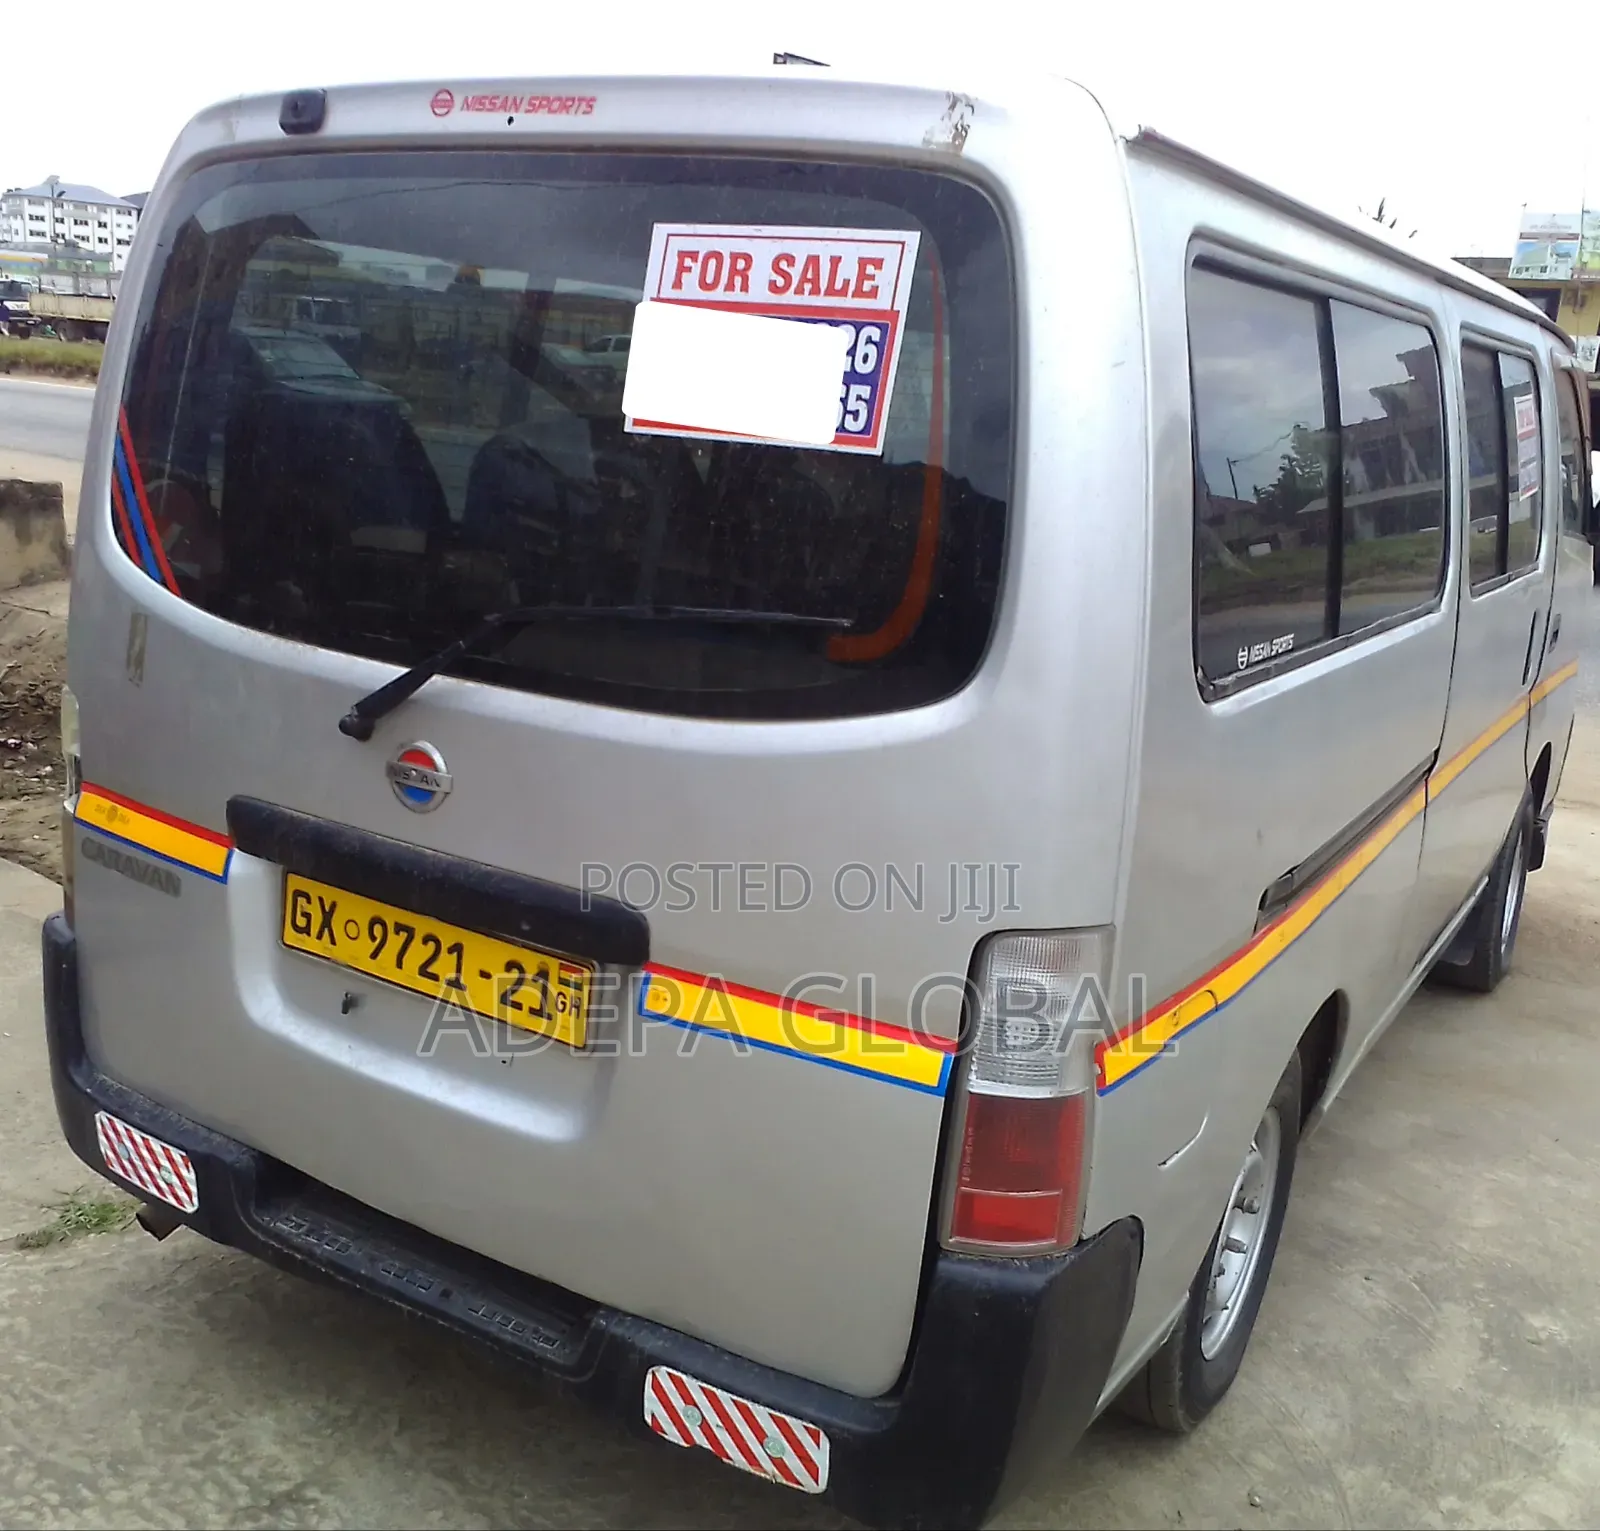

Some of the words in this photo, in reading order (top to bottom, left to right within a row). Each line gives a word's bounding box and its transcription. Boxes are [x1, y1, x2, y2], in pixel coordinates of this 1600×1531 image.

[460, 95, 523, 113] NISSAN
[525, 96, 597, 115] SPORTS
[671, 250, 753, 294] FOR
[767, 253, 884, 300] SALE
[81, 836, 182, 898] CARAVAN
[291, 889, 337, 946] GX
